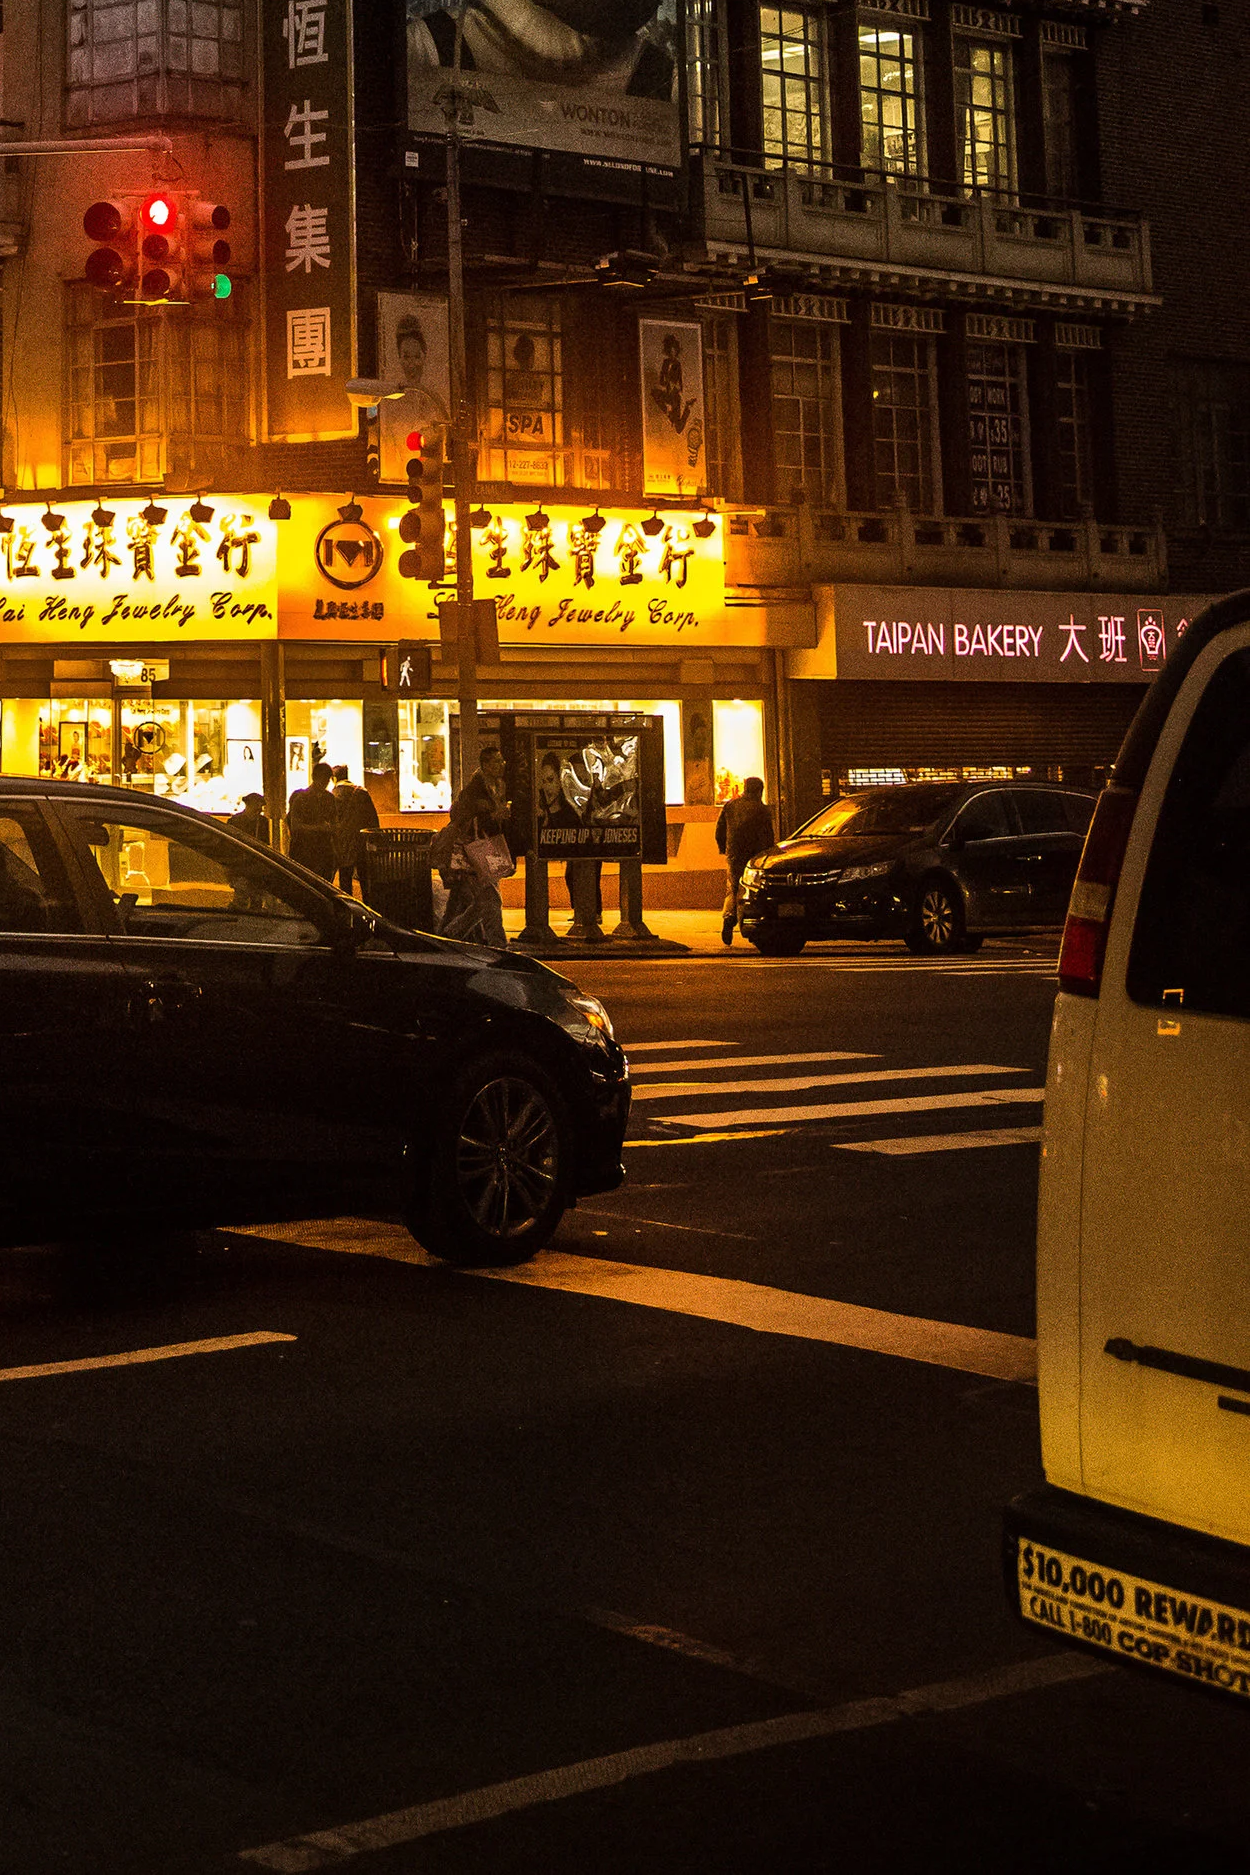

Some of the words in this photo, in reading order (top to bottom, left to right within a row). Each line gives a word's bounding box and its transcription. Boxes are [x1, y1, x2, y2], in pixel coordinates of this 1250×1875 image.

[508, 415, 544, 435] SPA
[39, 595, 95, 629] Heng
[102, 594, 195, 627] Jewelry
[210, 592, 273, 625] Corp.
[548, 599, 636, 632] Jewelry
[648, 599, 699, 631] Corp.
[863, 621, 944, 655] TAIPAN
[955, 624, 1043, 657] BAKERY
[1058, 614, 1127, 663] 大班
[141, 668, 156, 683] 85
[540, 828, 577, 844] KEEPING
[578, 828, 590, 843] UP
[603, 828, 638, 843] JONESES
[1022, 1544, 1124, 1609] $10,000
[1029, 1595, 1062, 1628] CALL
[1069, 1610, 1111, 1645] 1-800
[1117, 1630, 1170, 1662] COP
